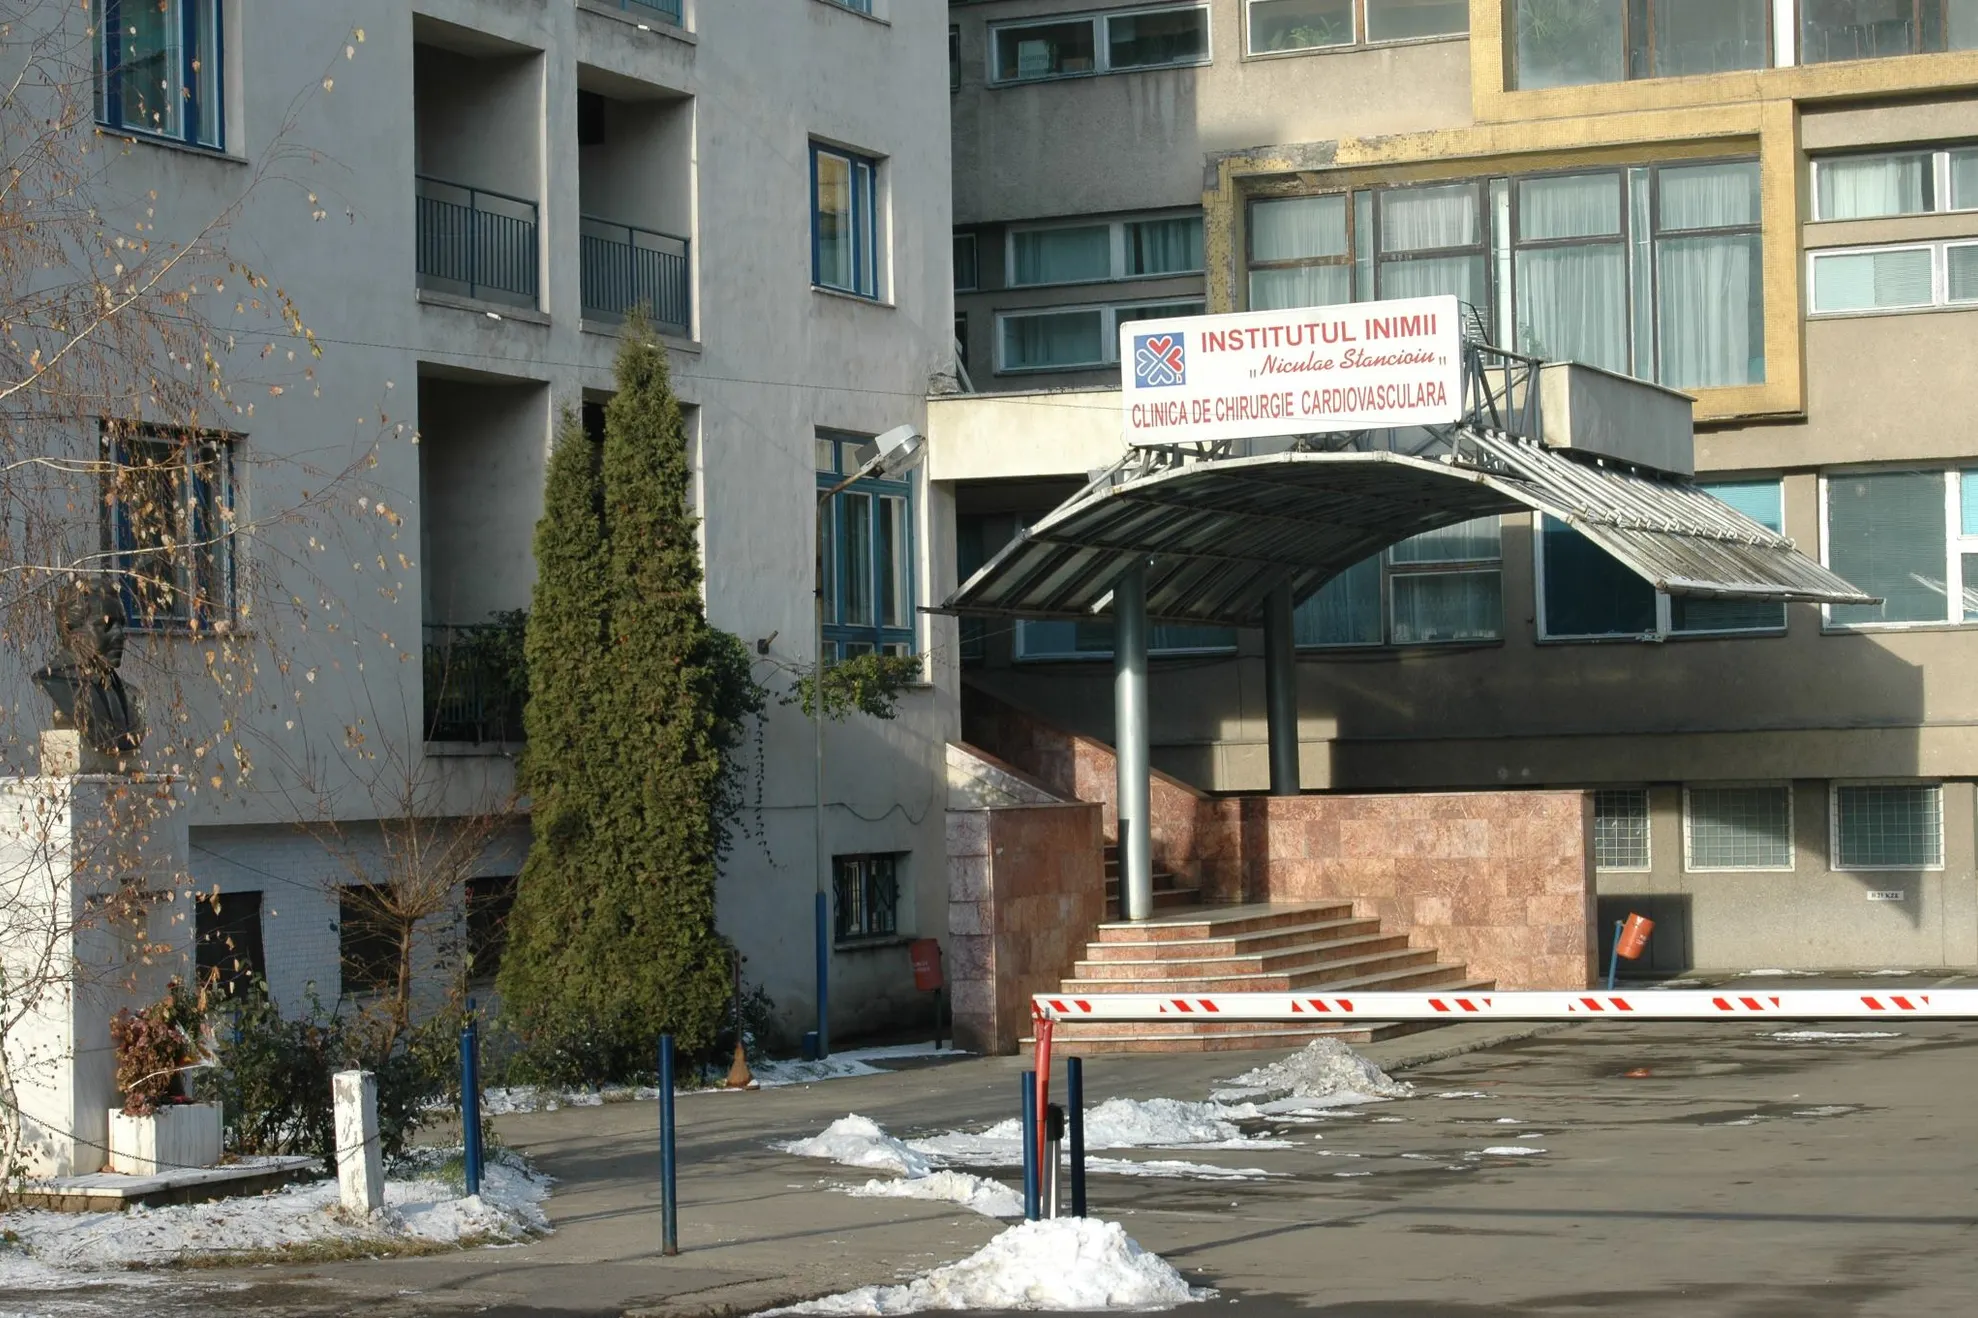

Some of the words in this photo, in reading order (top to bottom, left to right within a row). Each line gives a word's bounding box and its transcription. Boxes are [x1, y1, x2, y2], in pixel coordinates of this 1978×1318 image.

[1202, 320, 1357, 353] INSTITUTUL
[1365, 313, 1437, 340] INIMII
[1132, 401, 1189, 428] CLINICA
[1192, 399, 1211, 424] DE
[1215, 391, 1294, 422] CHIRURGIE
[1301, 380, 1448, 415] CARDIOVASCULARA
